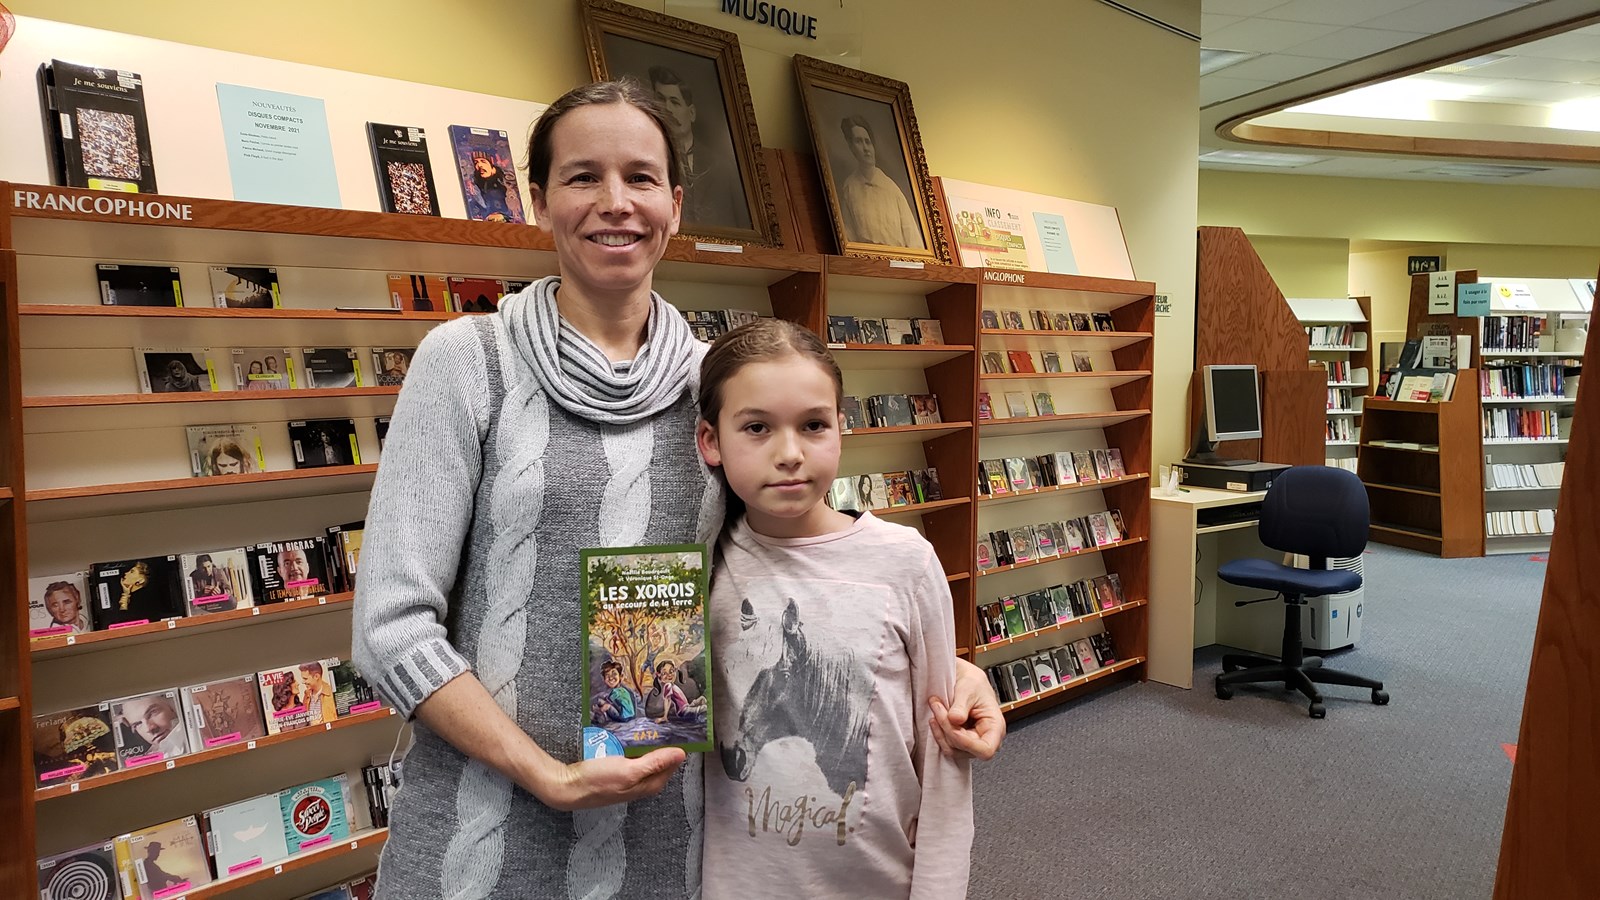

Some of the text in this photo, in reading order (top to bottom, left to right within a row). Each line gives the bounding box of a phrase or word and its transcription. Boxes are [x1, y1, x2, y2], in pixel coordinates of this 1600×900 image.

[721, 0, 817, 40] MUSIQUE
[73, 77, 82, 86] Je
[96, 82, 128, 93] souviens
[248, 111, 303, 124] DISQUES COMPACTS
[255, 122, 286, 131] NOVEMBRE
[13, 190, 193, 221] FRANCOPHONE
[984, 207, 1001, 219] INFO
[988, 219, 1022, 231] CLASSEMENT
[983, 271, 1025, 284] ANGLOPHONE
[267, 539, 315, 554] DAN BIGRAS
[600, 582, 695, 602] LES XOROIS
[602, 602, 615, 610] au
[616, 601, 647, 609] secours
[672, 598, 693, 606] Terre
[263, 671, 284, 682] LA VIE
[36, 717, 67, 729] Ferland
[120, 746, 144, 757] GAROU
